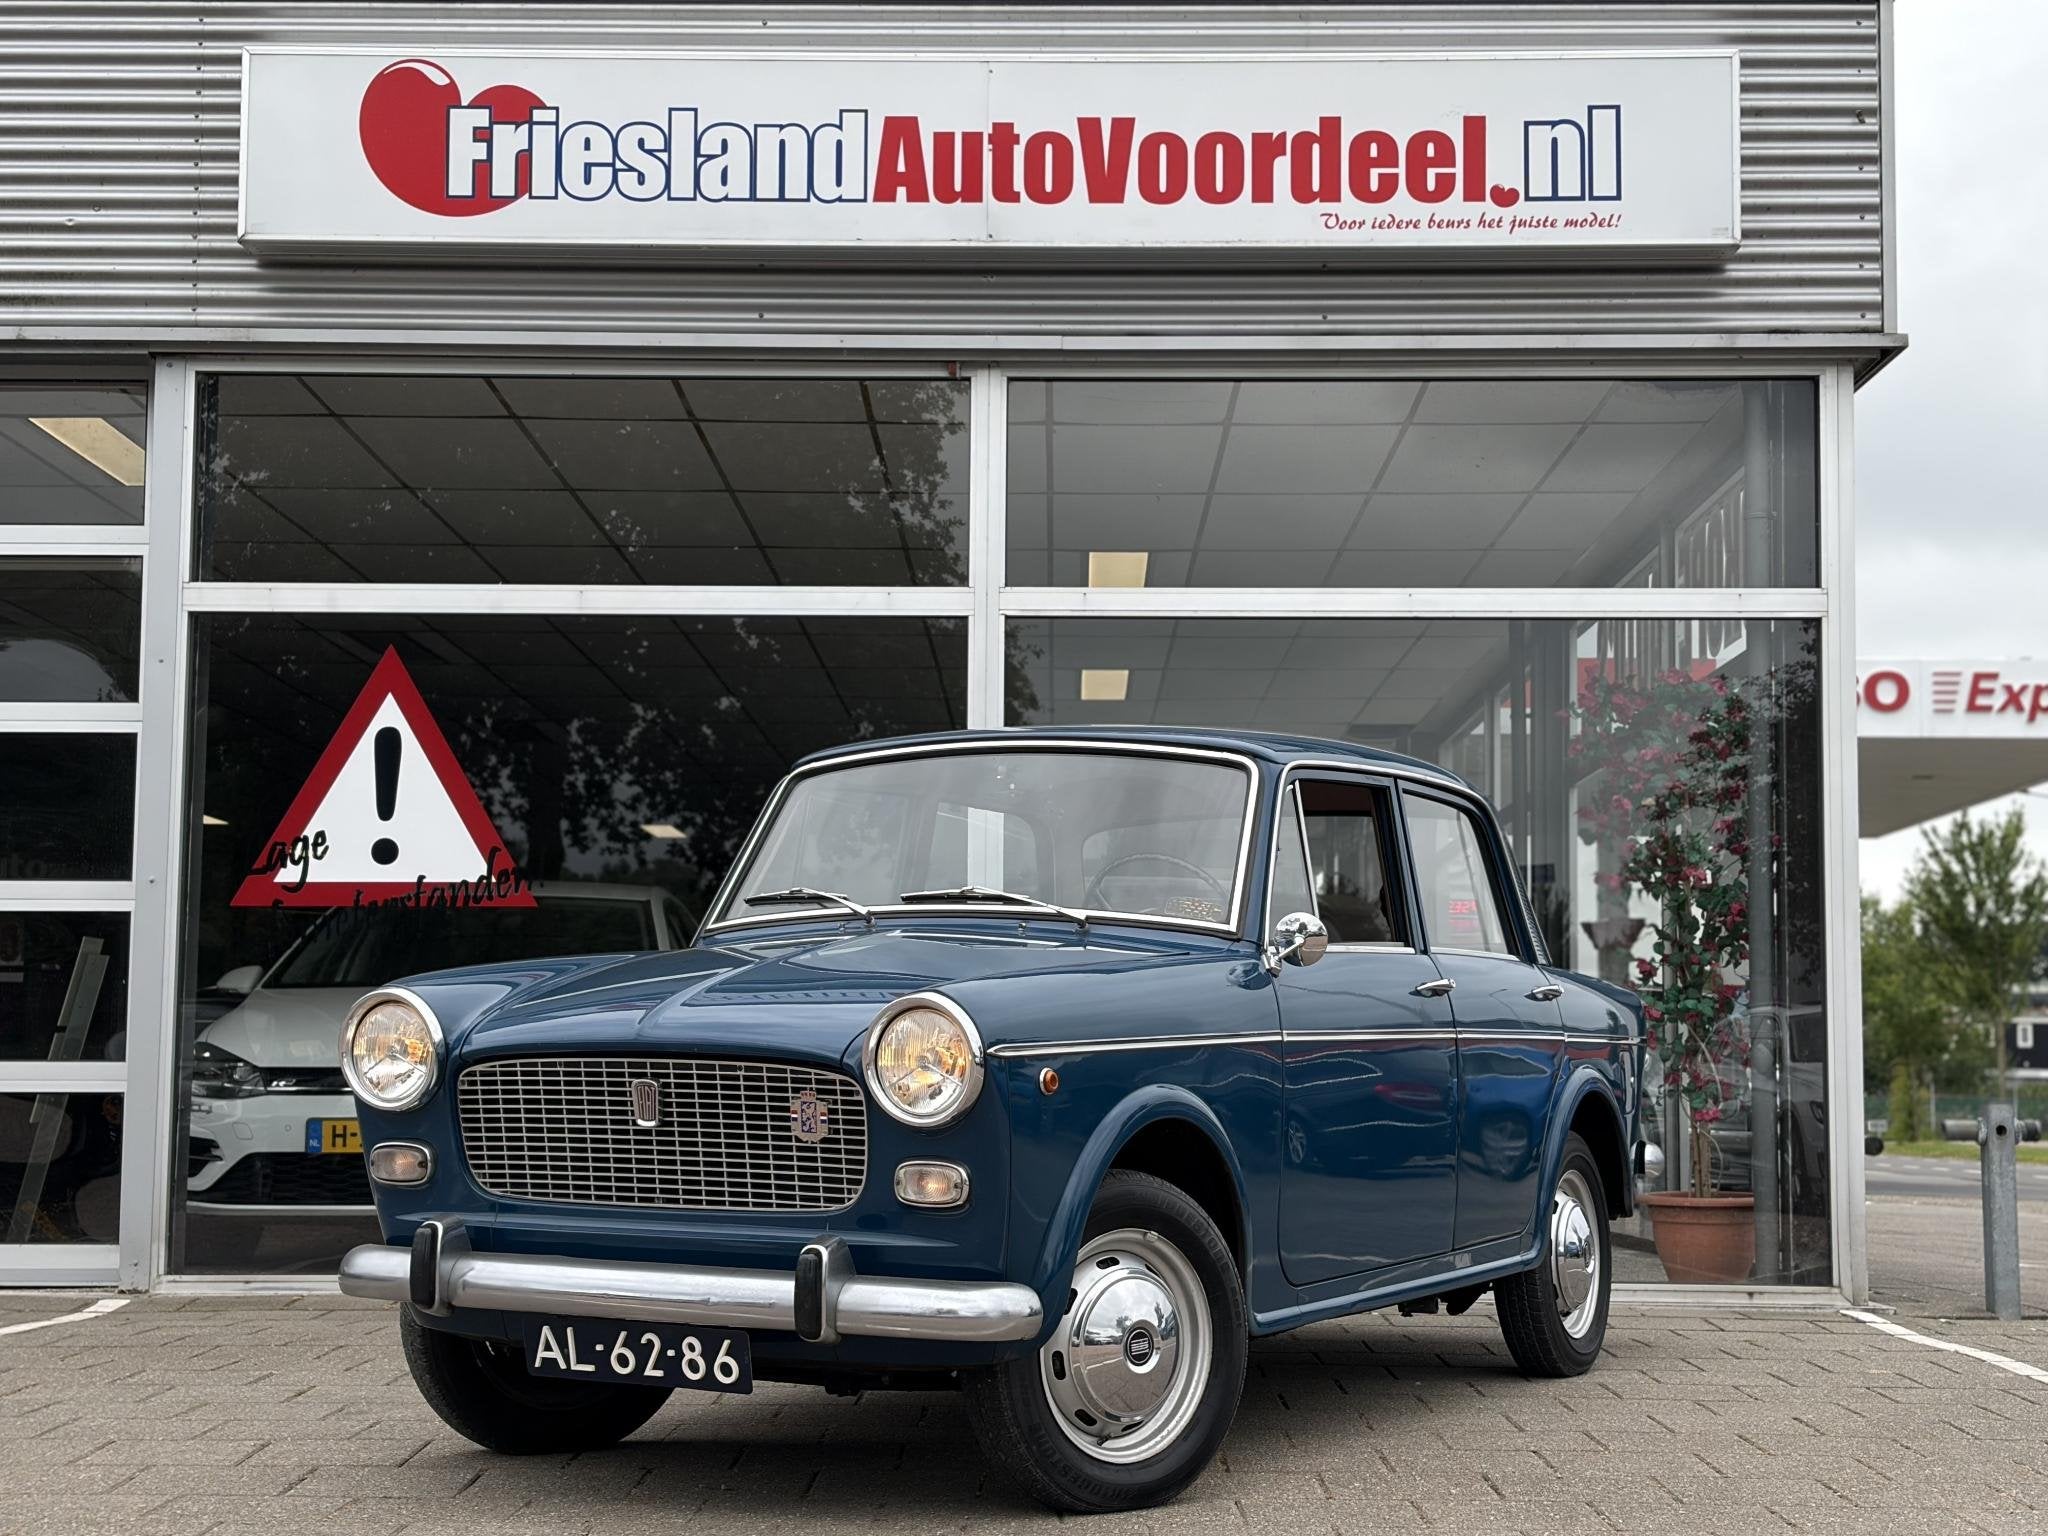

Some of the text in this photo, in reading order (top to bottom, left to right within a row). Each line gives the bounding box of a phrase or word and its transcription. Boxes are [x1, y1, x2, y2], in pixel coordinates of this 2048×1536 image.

[1320, 211, 1622, 235] Voor iedere beurs het juiste model!
[1856, 670, 1911, 714] O
[309, 1138, 321, 1147] NL
[331, 1124, 363, 1148] H-
[534, 1325, 740, 1385] AL-62-86
